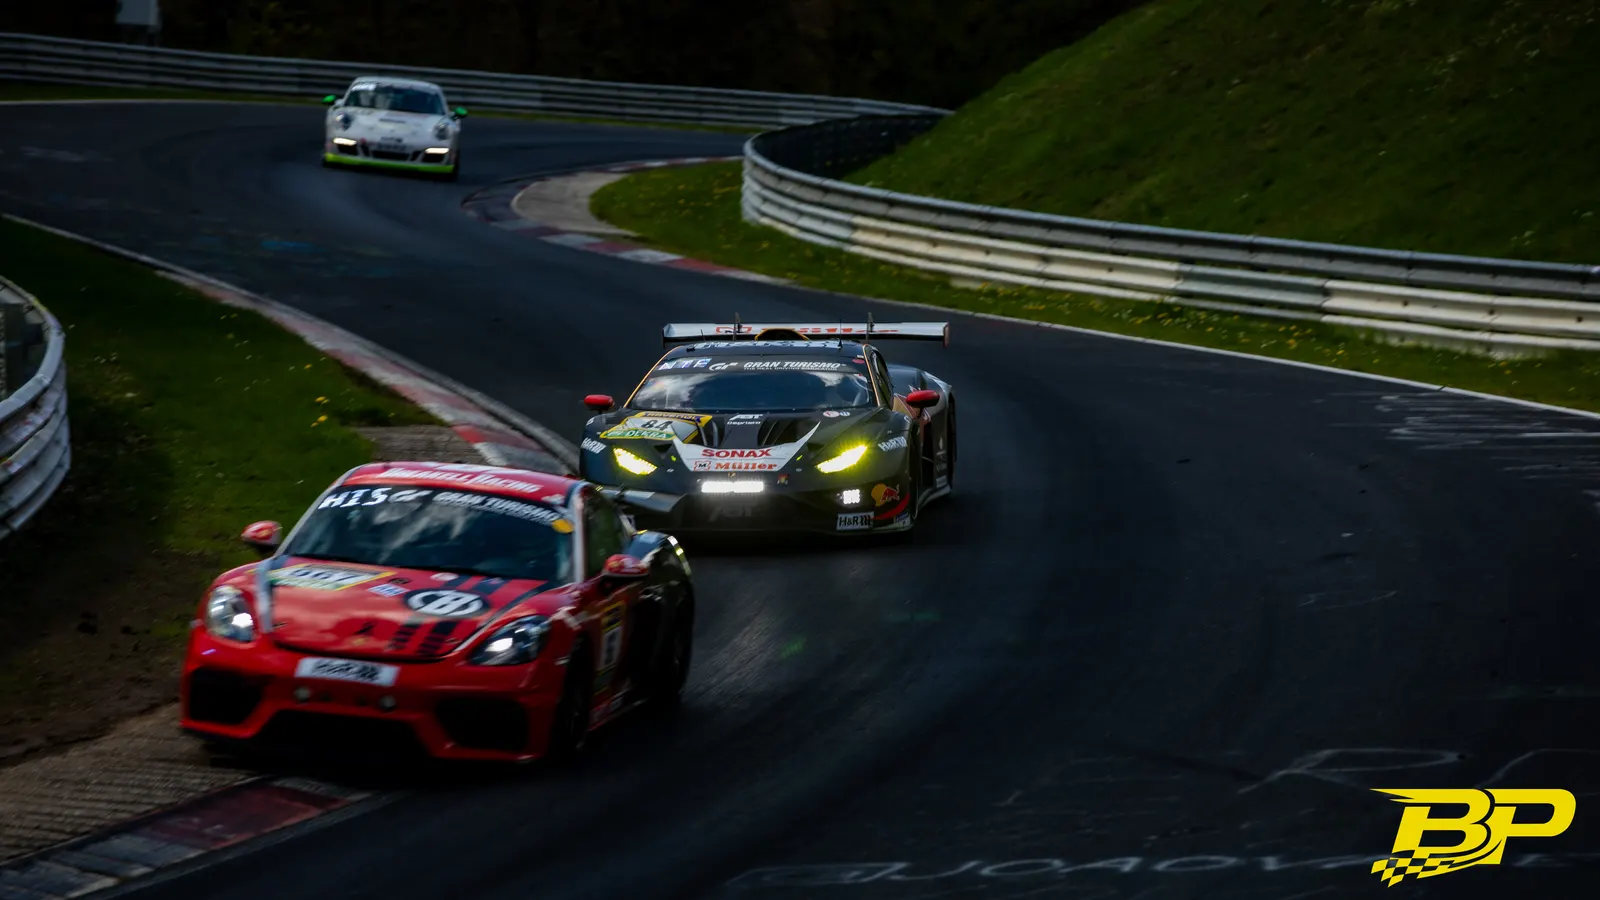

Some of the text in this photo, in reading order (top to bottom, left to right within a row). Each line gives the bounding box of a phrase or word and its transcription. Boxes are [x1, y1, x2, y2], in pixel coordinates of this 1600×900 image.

[783, 361, 840, 369] TURISMO
[641, 420, 674, 431] 84
[625, 430, 667, 439] DEKRA
[702, 448, 771, 459] SONAX
[714, 461, 777, 470] Müller
[318, 487, 393, 510] HIS
